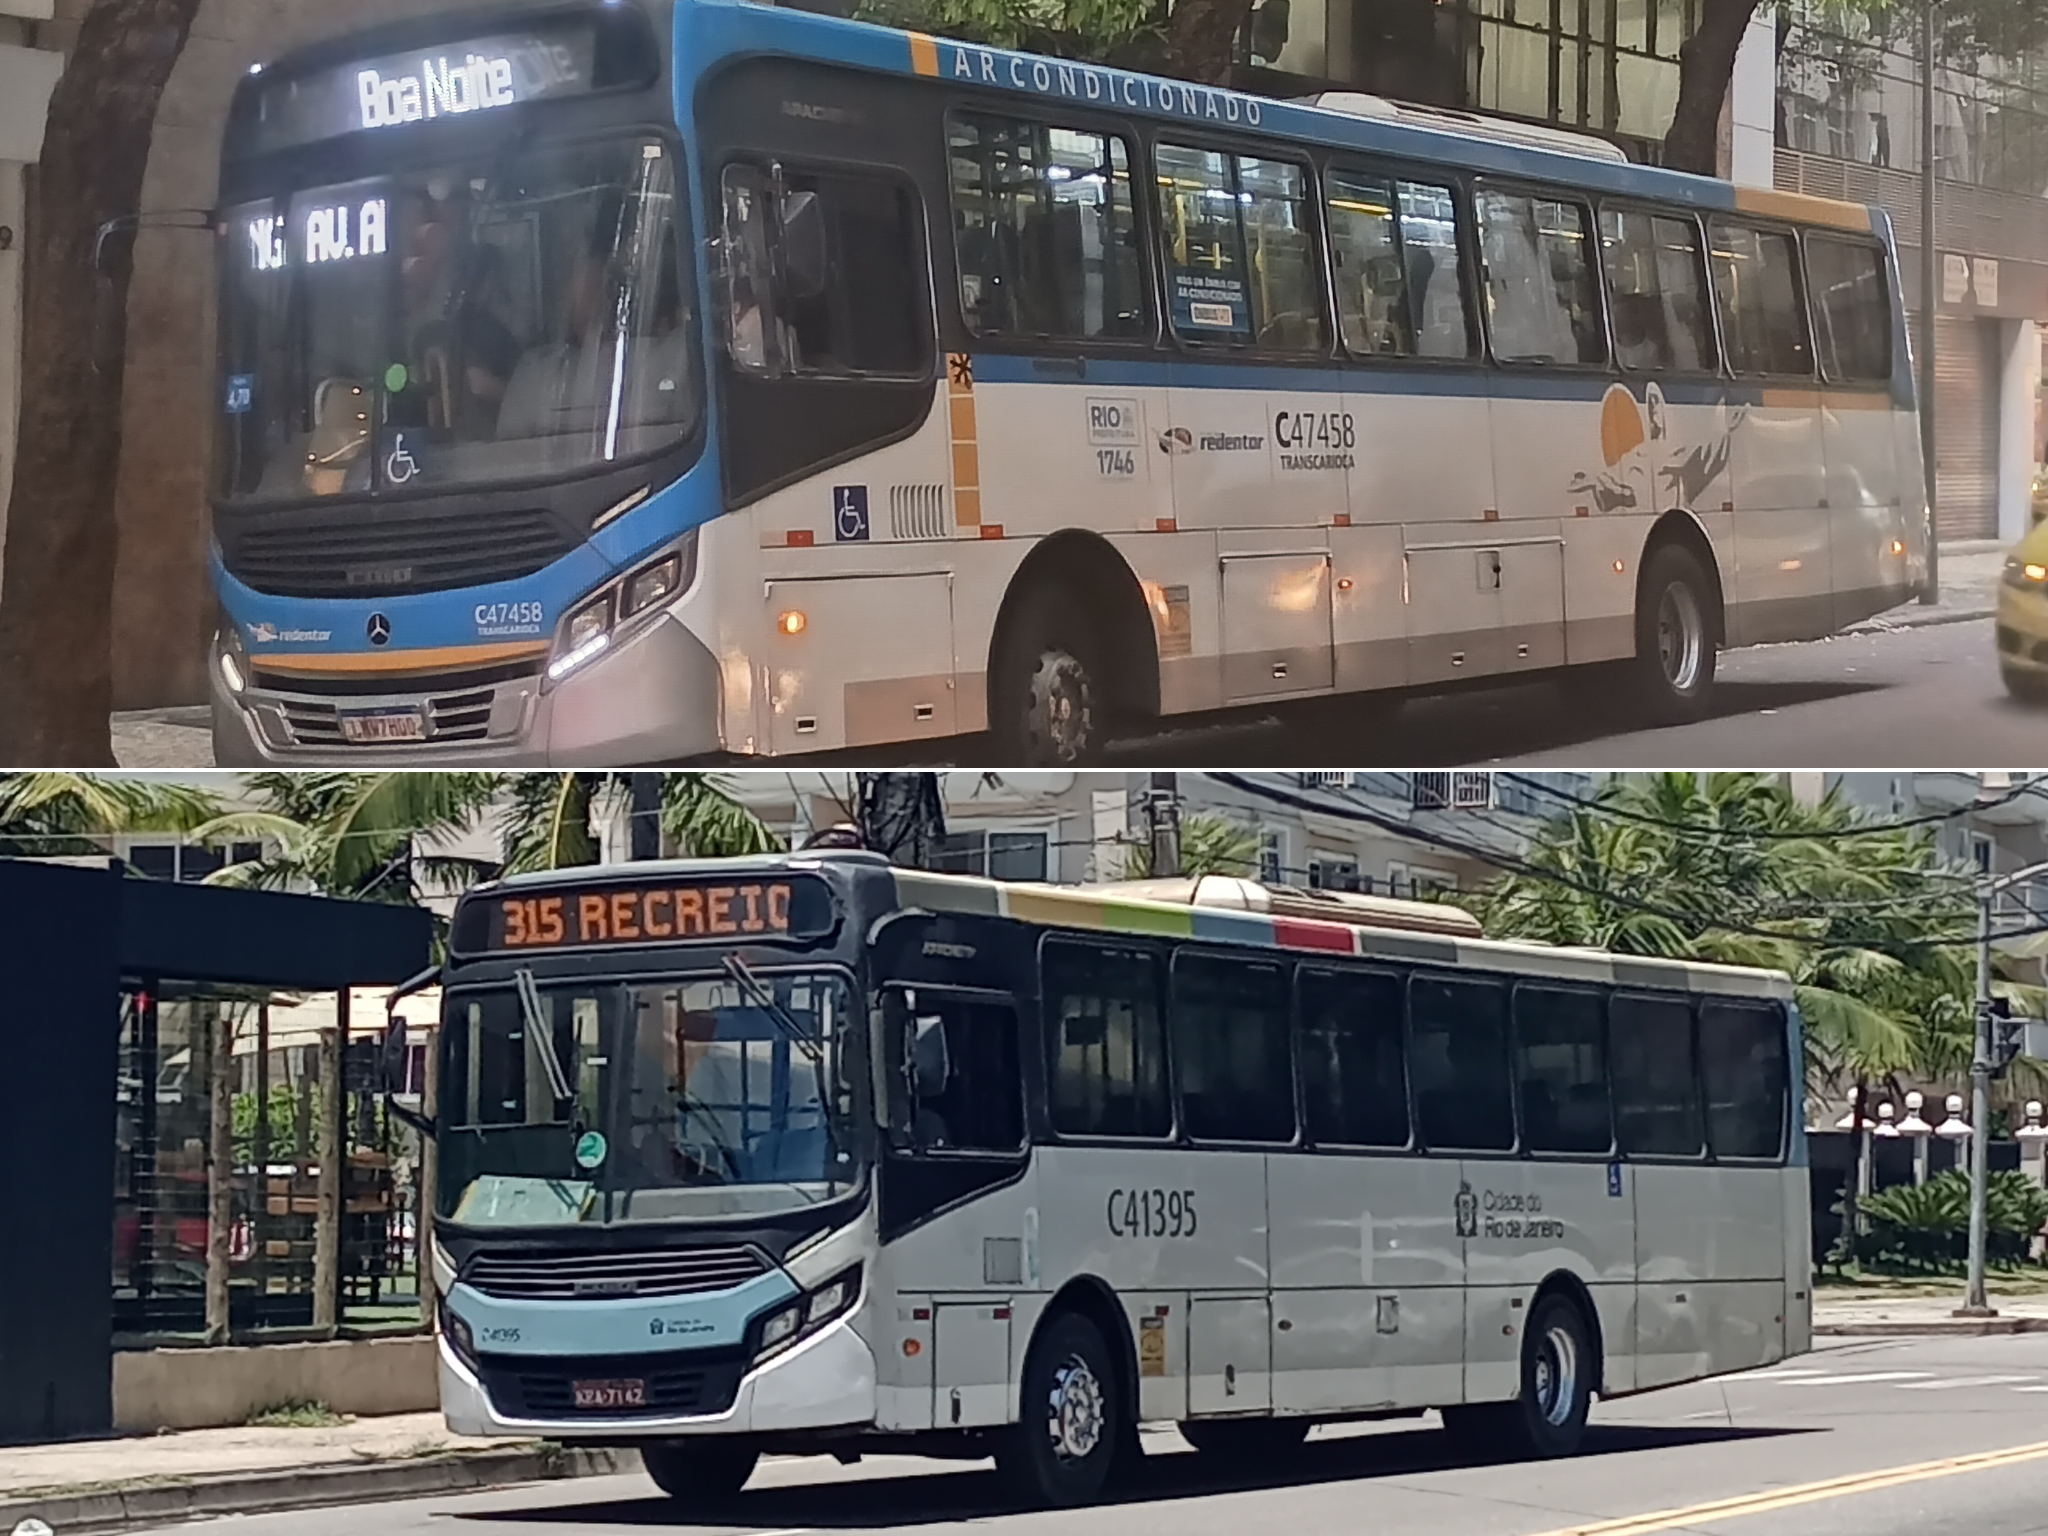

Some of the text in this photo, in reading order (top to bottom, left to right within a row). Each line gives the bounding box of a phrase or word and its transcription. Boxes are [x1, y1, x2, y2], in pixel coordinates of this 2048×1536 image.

[358, 68, 422, 128] Boa
[423, 54, 514, 118] Noite
[955, 48, 1260, 125] AR CONDICIONADO
[1091, 405, 1121, 428] RIO
[1200, 433, 1264, 450] redentor
[1275, 412, 1356, 449] C47458
[1096, 449, 1135, 475] 1746
[1280, 455, 1356, 471] TRANSCARIOCA
[474, 601, 543, 625] C47458
[279, 628, 331, 642] redentor
[502, 897, 563, 945] 315
[1107, 1188, 1197, 1238] C41395
